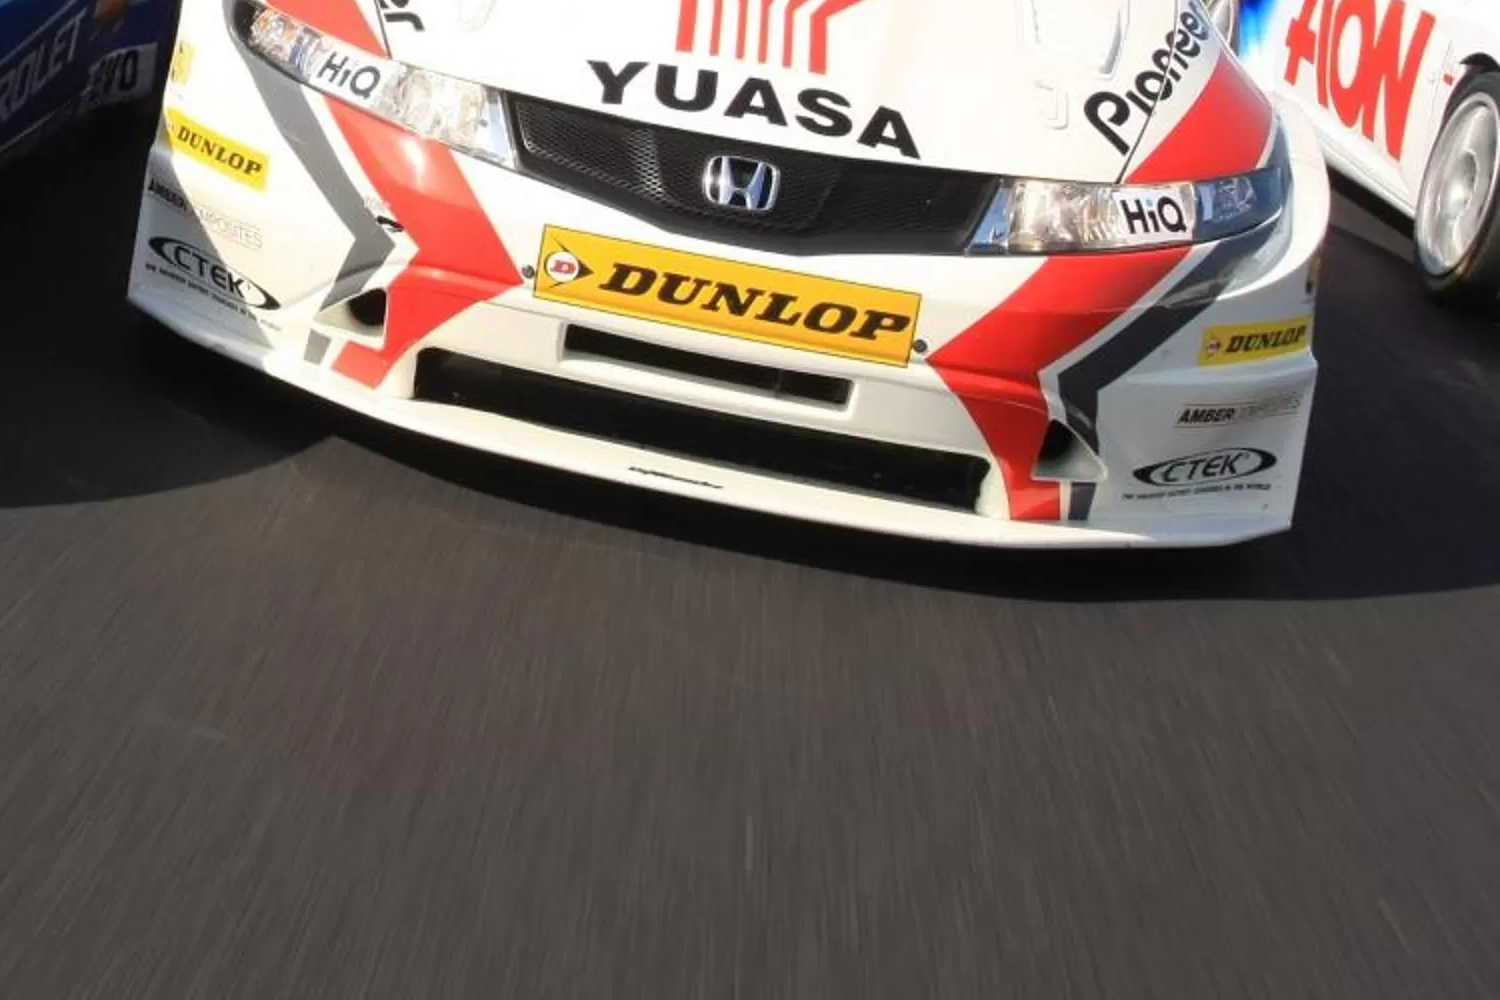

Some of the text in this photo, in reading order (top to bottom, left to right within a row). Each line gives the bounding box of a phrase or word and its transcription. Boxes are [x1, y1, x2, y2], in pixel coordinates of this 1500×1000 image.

[1084, 1, 1209, 156] Pioneer
[586, 59, 921, 160] YUASA
[178, 125, 263, 176] DUNLOP
[1120, 195, 1187, 234] HiQ
[173, 245, 245, 299] CTEK
[598, 261, 912, 341] DUNLOP
[1226, 324, 1307, 353] DUNLOP
[1178, 407, 1236, 424] AMBER
[1162, 452, 1244, 483] CTEK
